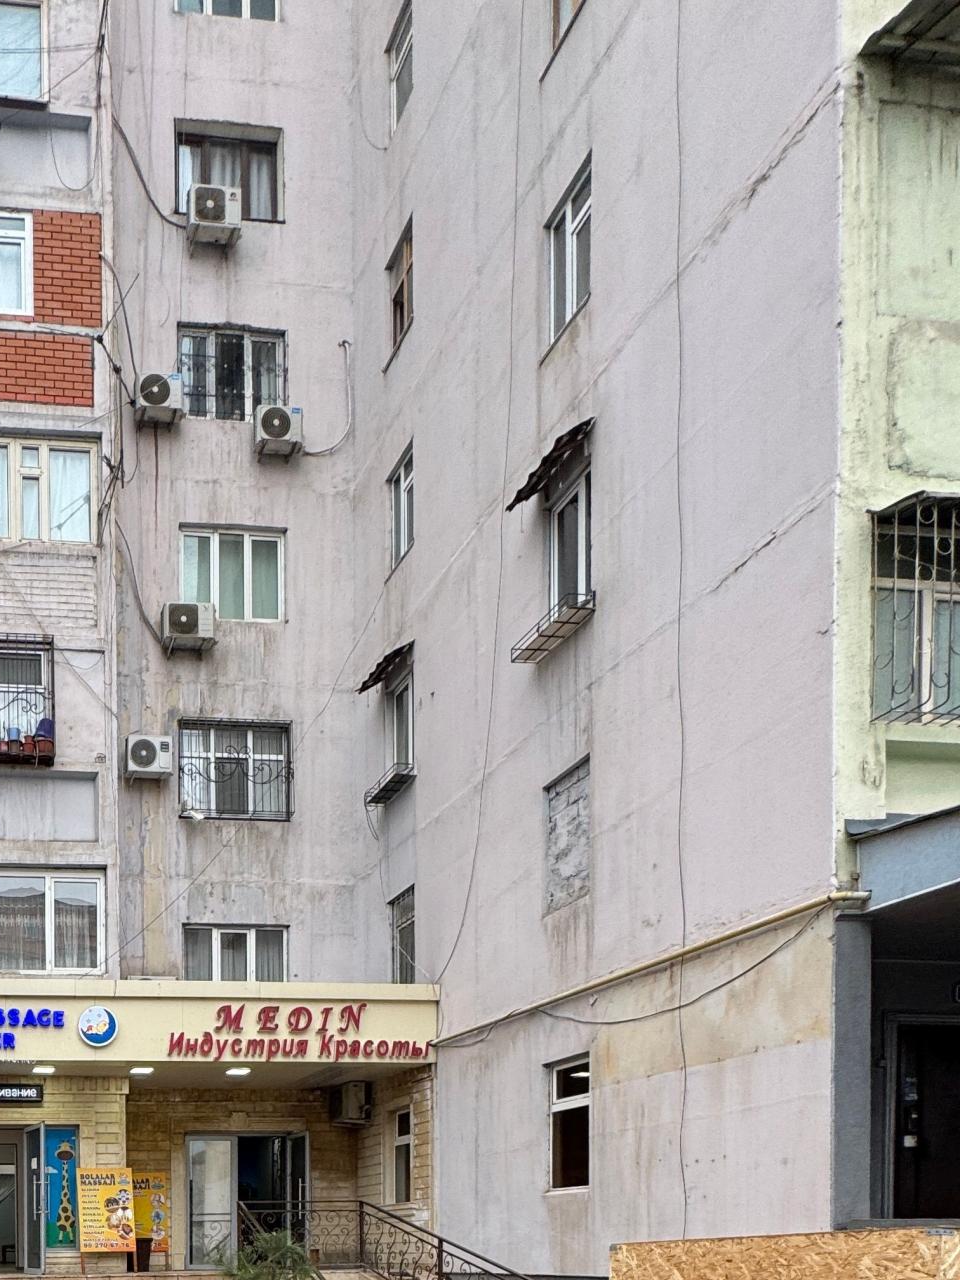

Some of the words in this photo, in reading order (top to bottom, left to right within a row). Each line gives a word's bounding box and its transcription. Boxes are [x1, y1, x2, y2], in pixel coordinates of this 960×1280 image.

[214, 1003, 367, 1034] MEDIN
[168, 1031, 309, 1062] Индустрия
[318, 1033, 431, 1063] Красоты
[80, 1179, 116, 1187] MASSAJI
